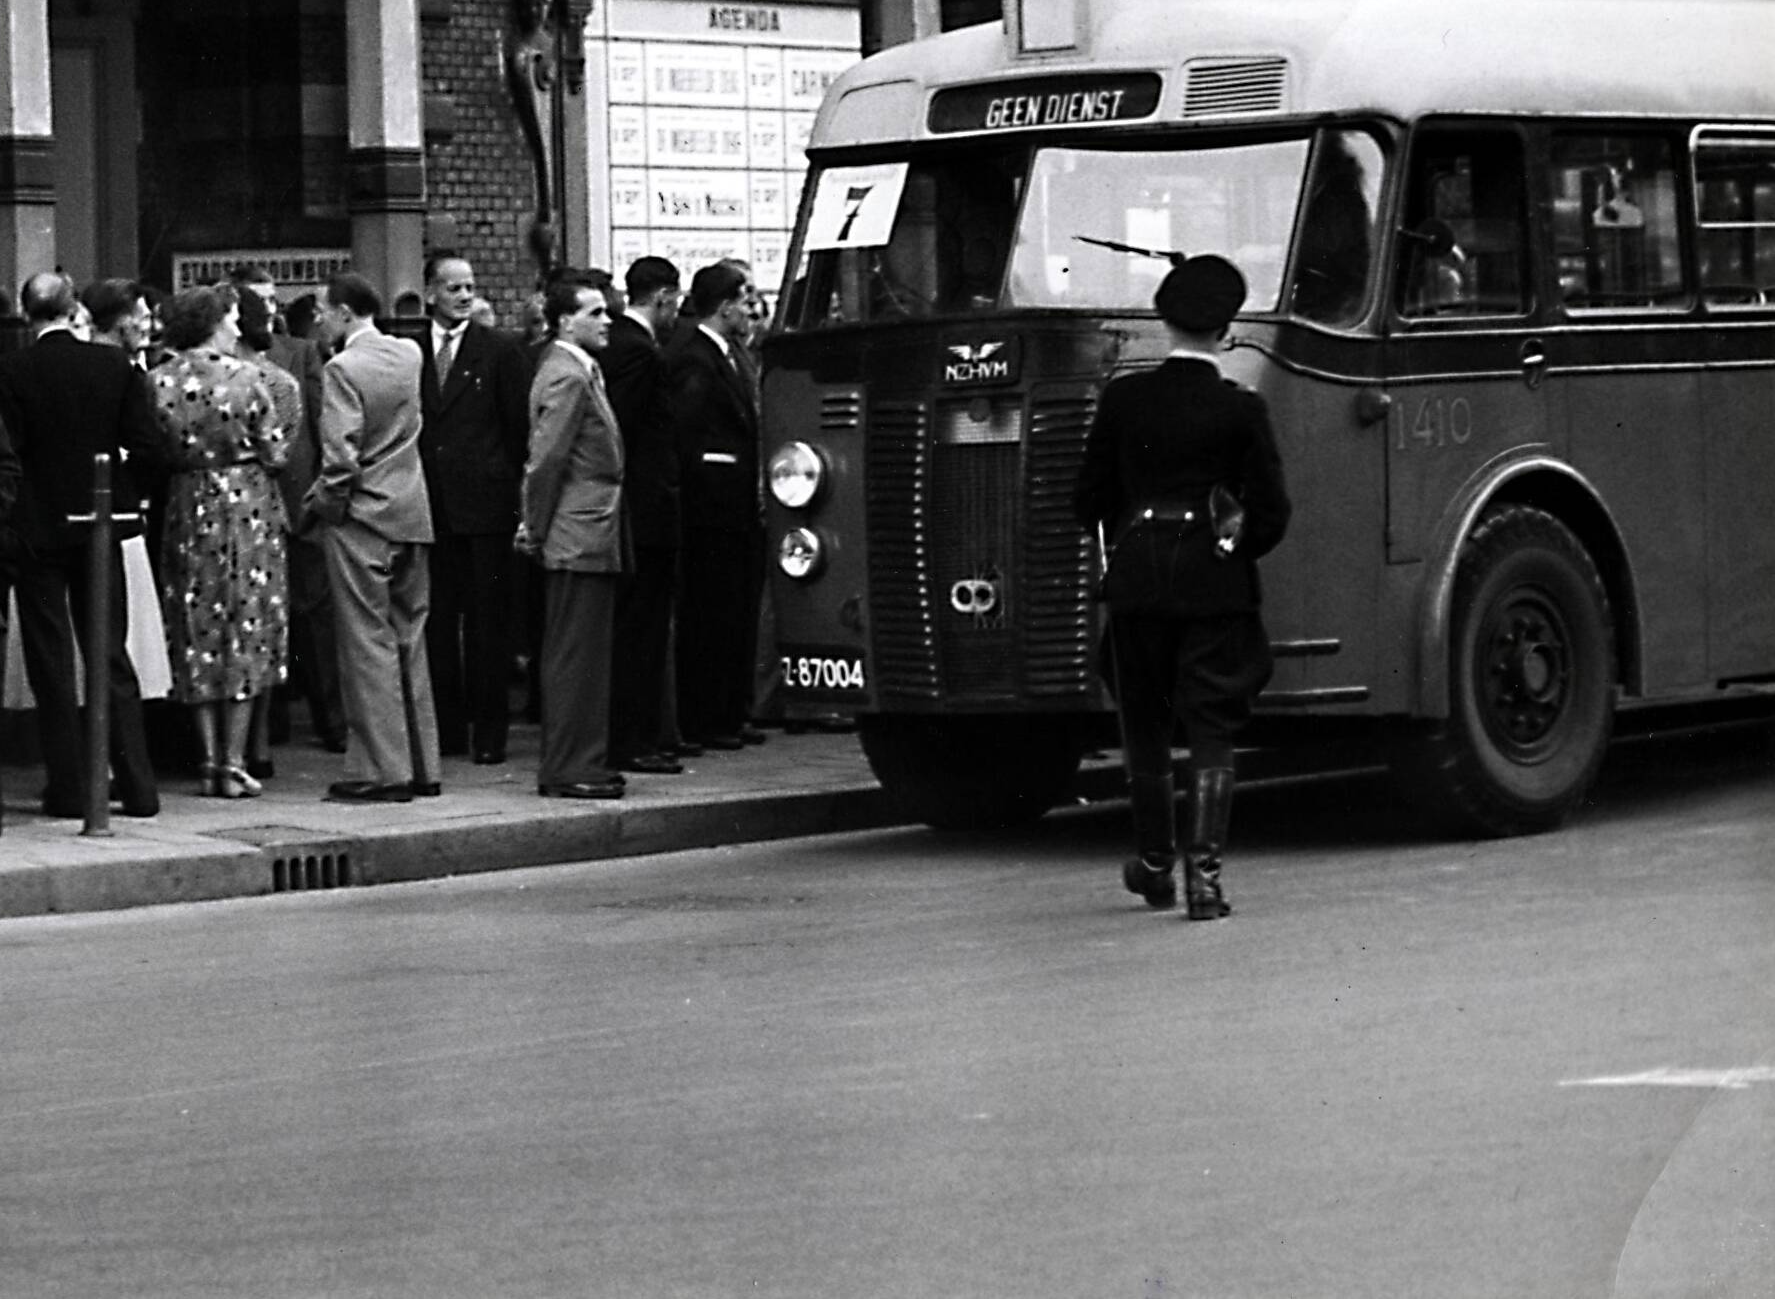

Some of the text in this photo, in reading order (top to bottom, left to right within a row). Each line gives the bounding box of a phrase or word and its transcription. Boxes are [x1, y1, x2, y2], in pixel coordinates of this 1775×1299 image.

[708, 7, 781, 32] AGENDA
[985, 90, 1125, 129] GEEN DIENST
[836, 184, 875, 242] 7
[945, 361, 1008, 382] NZHVM
[1396, 397, 1472, 450] 1410
